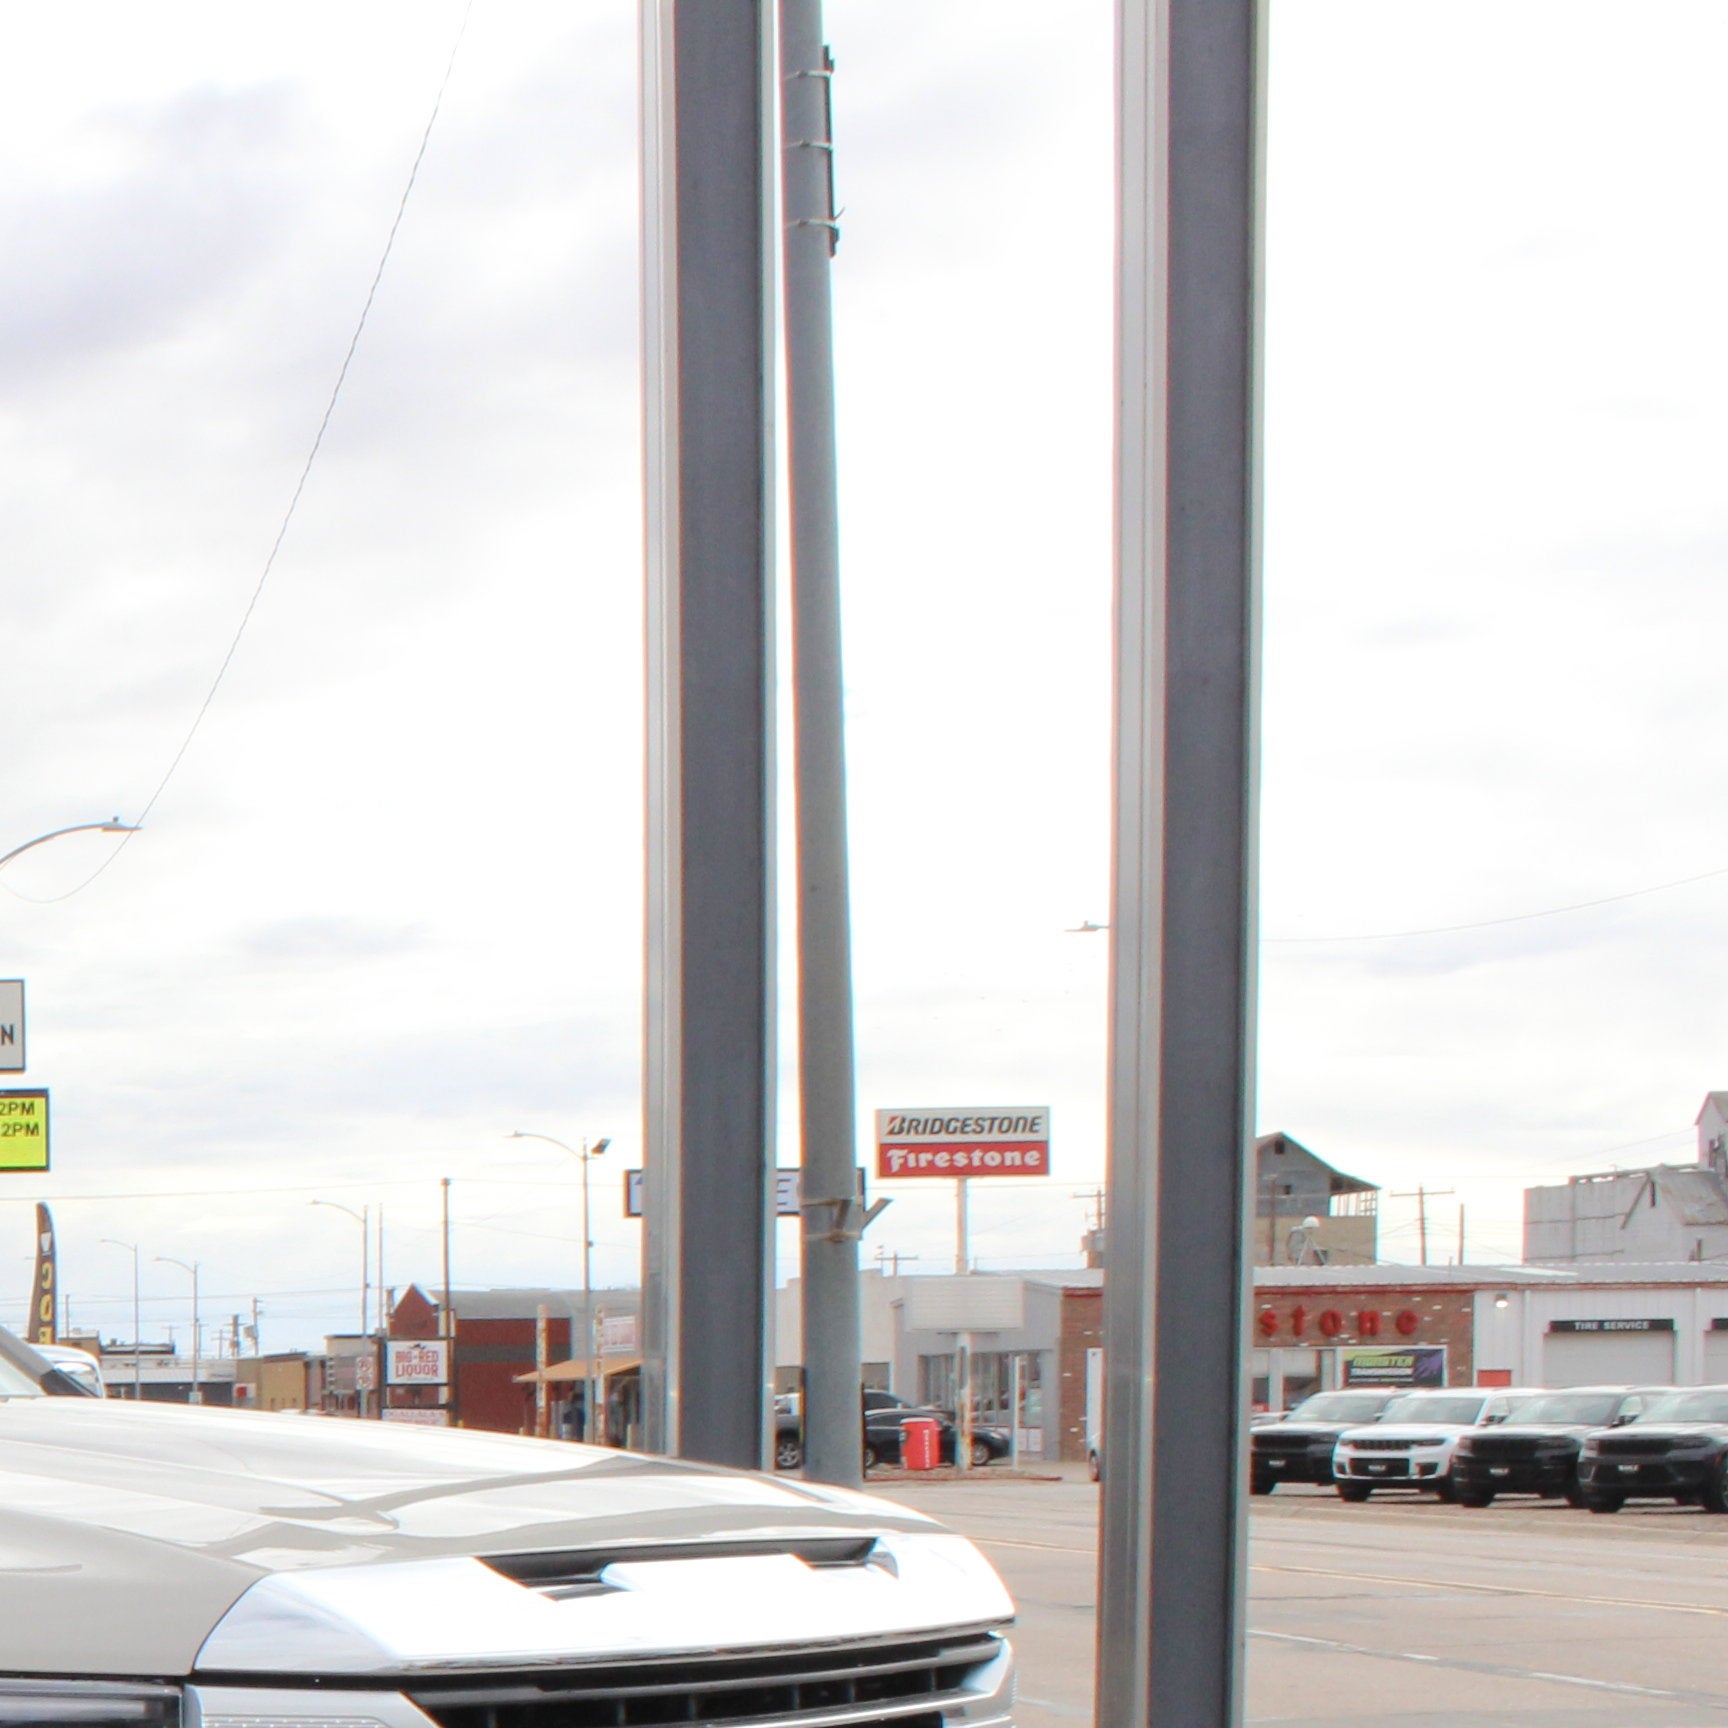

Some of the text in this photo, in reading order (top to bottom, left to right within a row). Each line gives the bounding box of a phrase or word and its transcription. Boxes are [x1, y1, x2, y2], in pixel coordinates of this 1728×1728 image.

[886, 1115, 1043, 1136] BRIDGESTONE
[886, 1148, 1041, 1173] Firestone
[1574, 1320, 1650, 1331] TIRE SERVICE
